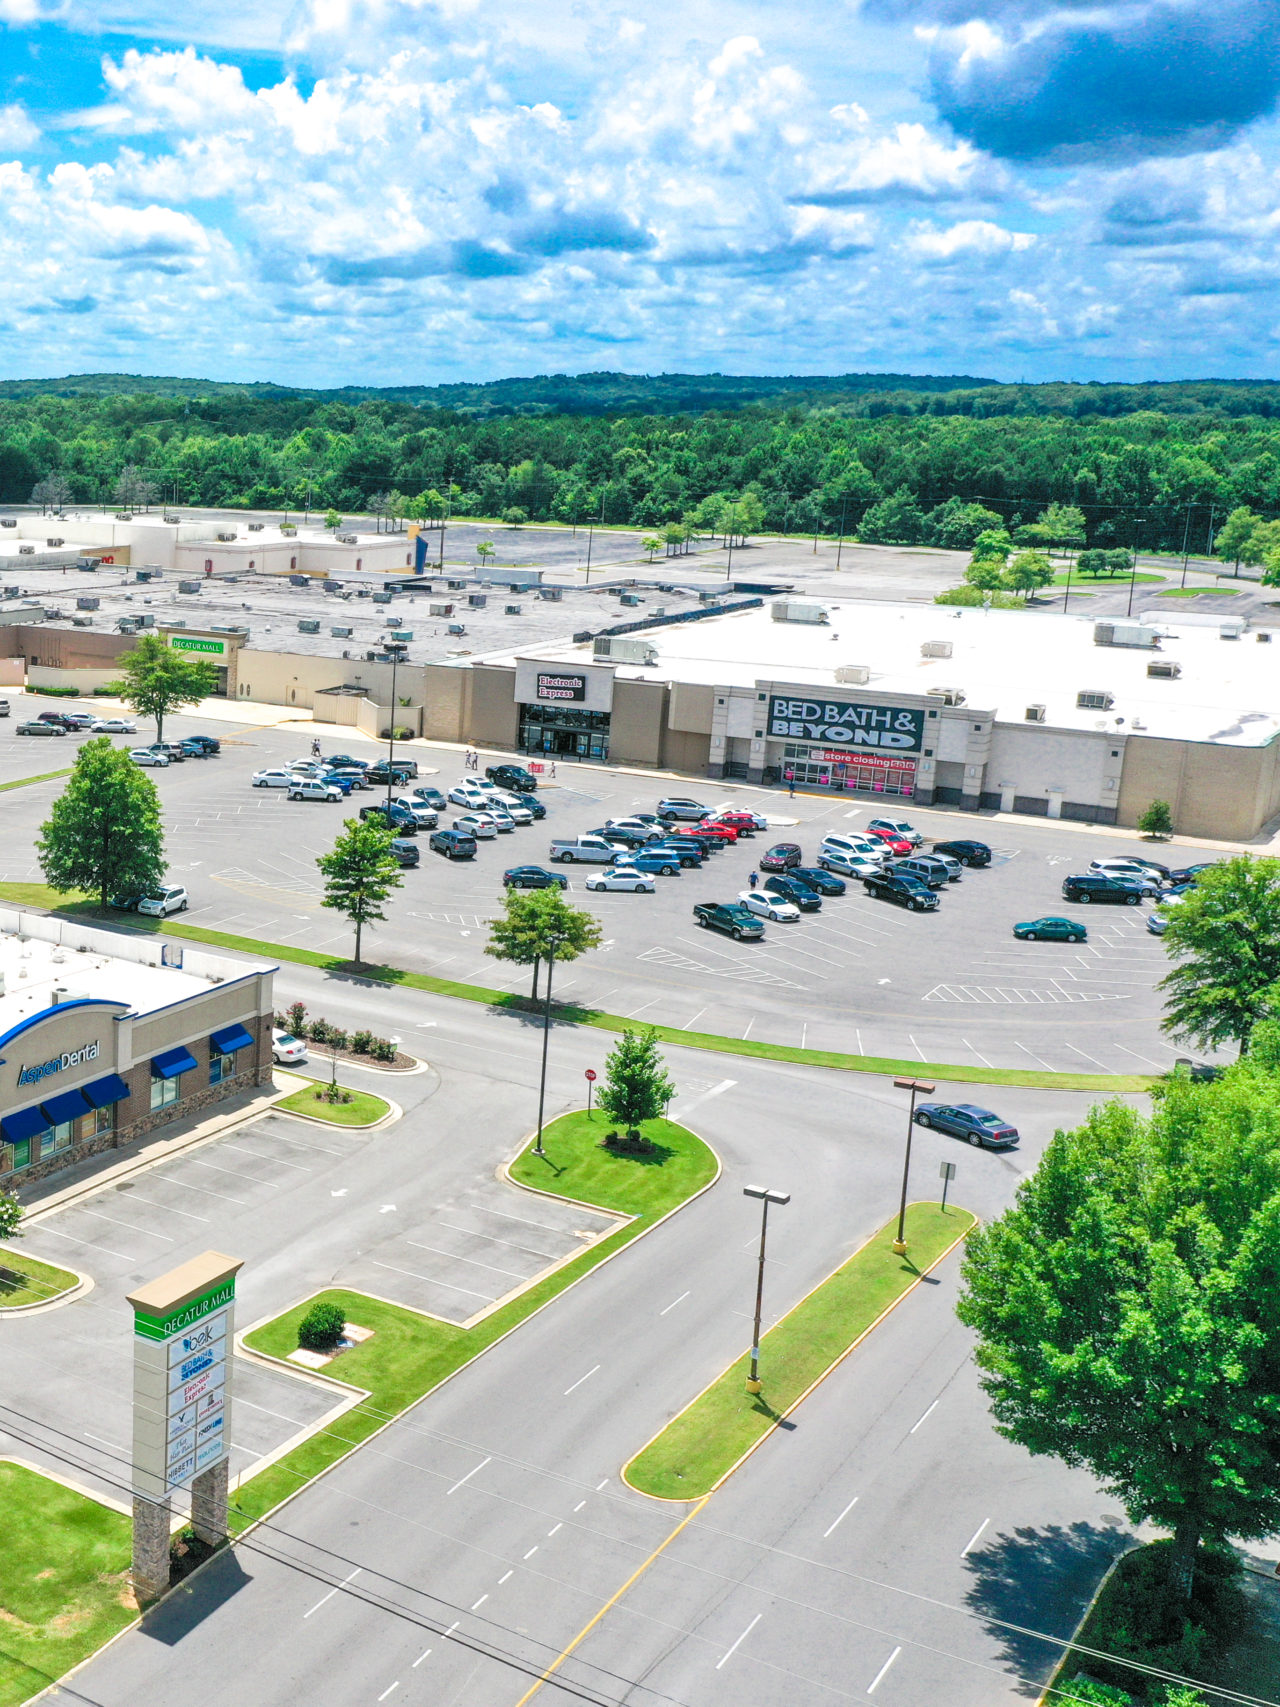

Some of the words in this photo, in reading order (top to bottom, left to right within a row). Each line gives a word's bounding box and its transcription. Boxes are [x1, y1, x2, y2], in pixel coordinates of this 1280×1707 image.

[173, 640, 201, 650] DECATUR
[202, 644, 220, 652] MALL
[539, 676, 582, 687] Electronic
[539, 687, 574, 699] Express
[773, 700, 821, 721] BED
[824, 705, 891, 729] BATH
[894, 712, 916, 732] &
[772, 720, 916, 748] BEYOND
[824, 753, 851, 762] store
[853, 756, 890, 768] closing
[164, 1300, 208, 1335] DECATUR
[210, 1285, 235, 1308] MALL
[190, 1326, 213, 1351] belk
[181, 1361, 193, 1373] BED
